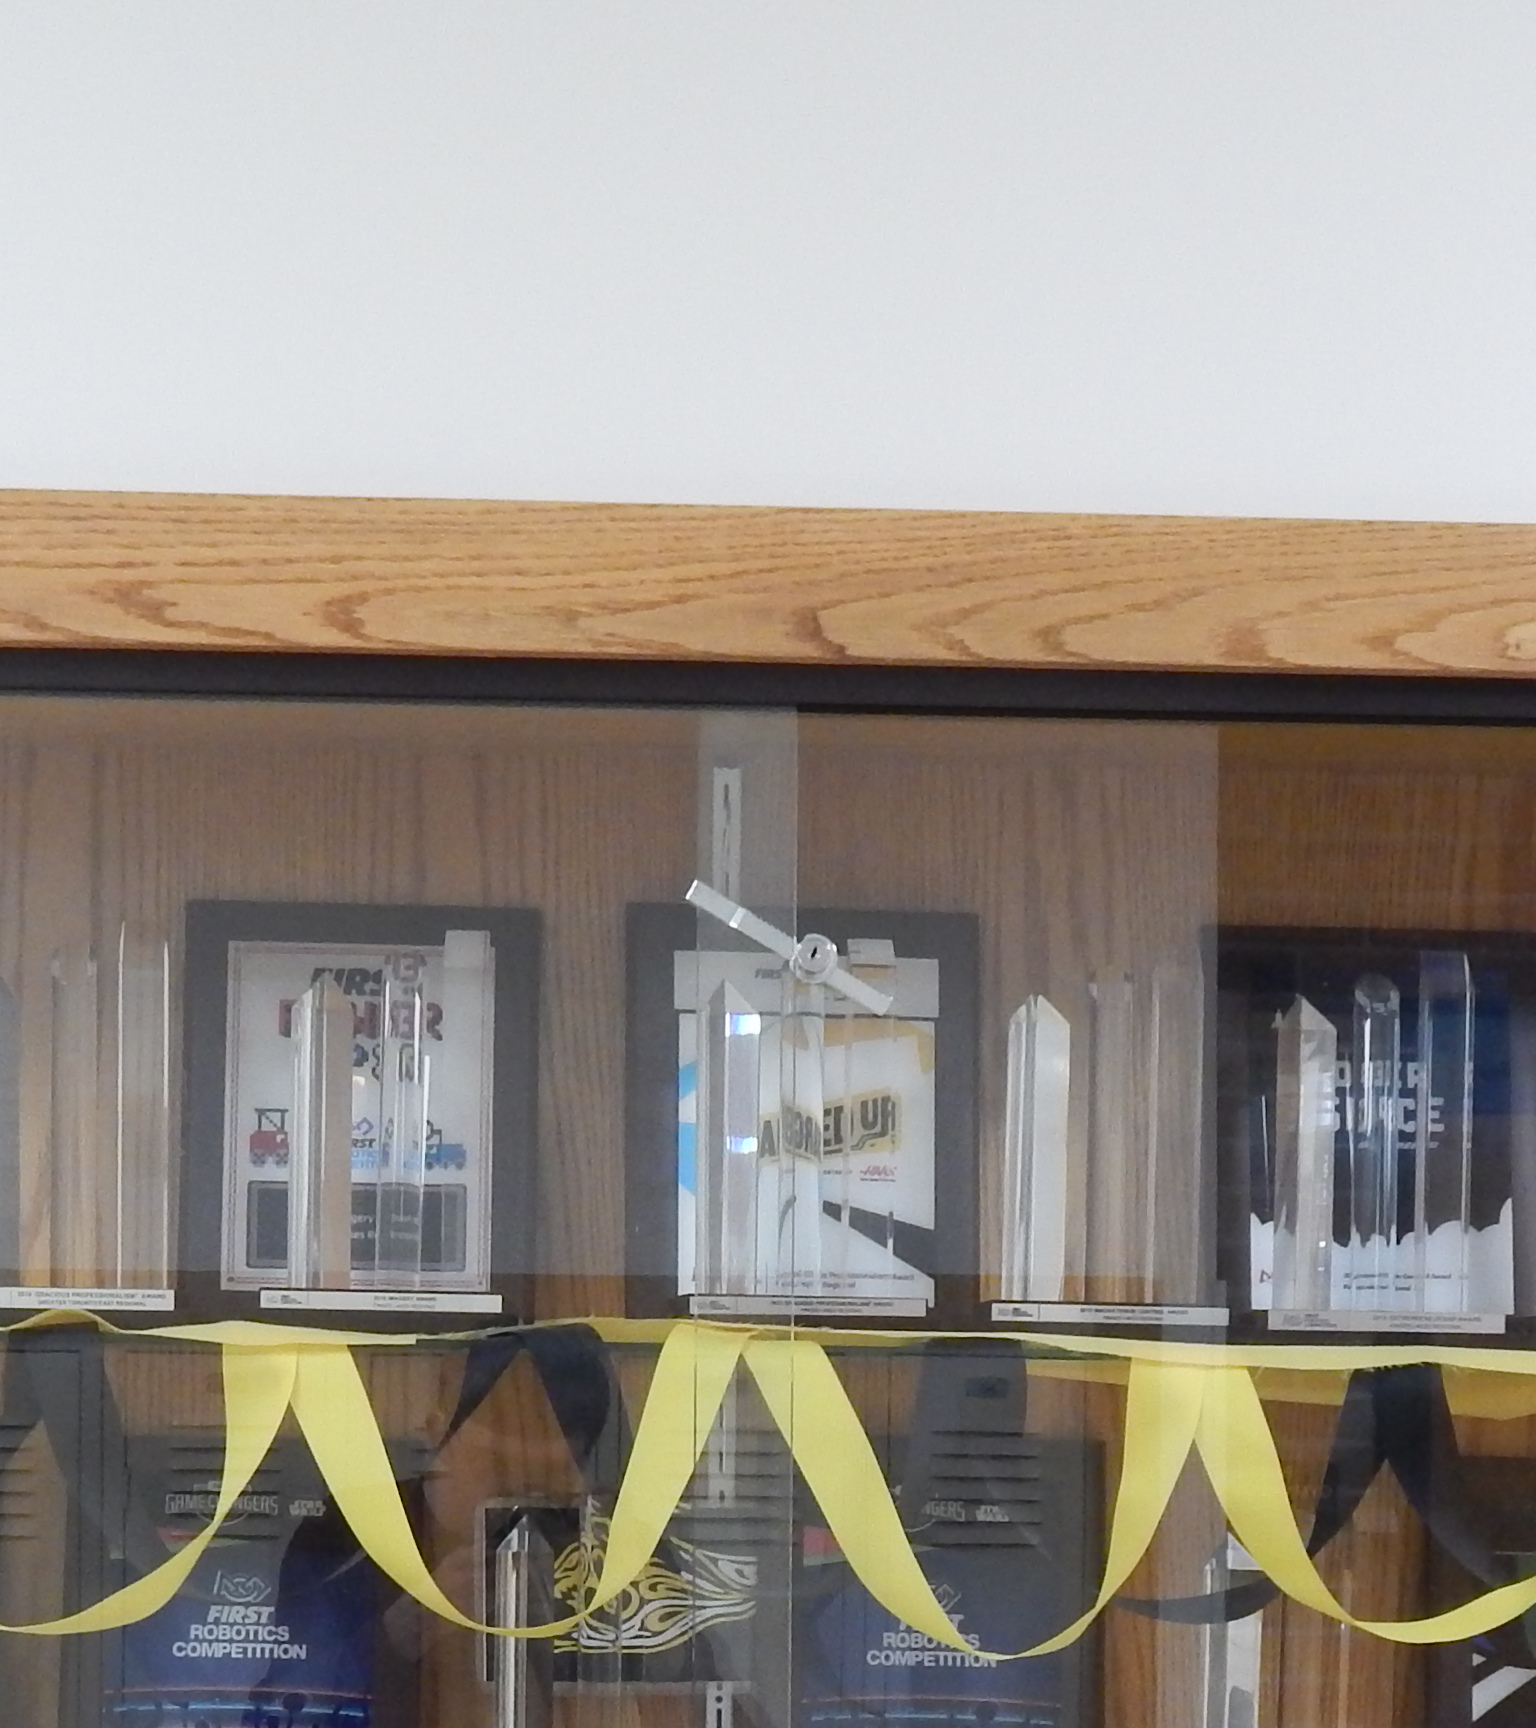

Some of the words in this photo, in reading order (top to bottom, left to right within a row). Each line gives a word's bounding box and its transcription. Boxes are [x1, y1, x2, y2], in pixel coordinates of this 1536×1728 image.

[207, 1605, 275, 1624] FIRST
[190, 1624, 290, 1641] ROBOTICS
[172, 1642, 307, 1660] COMPETITION
